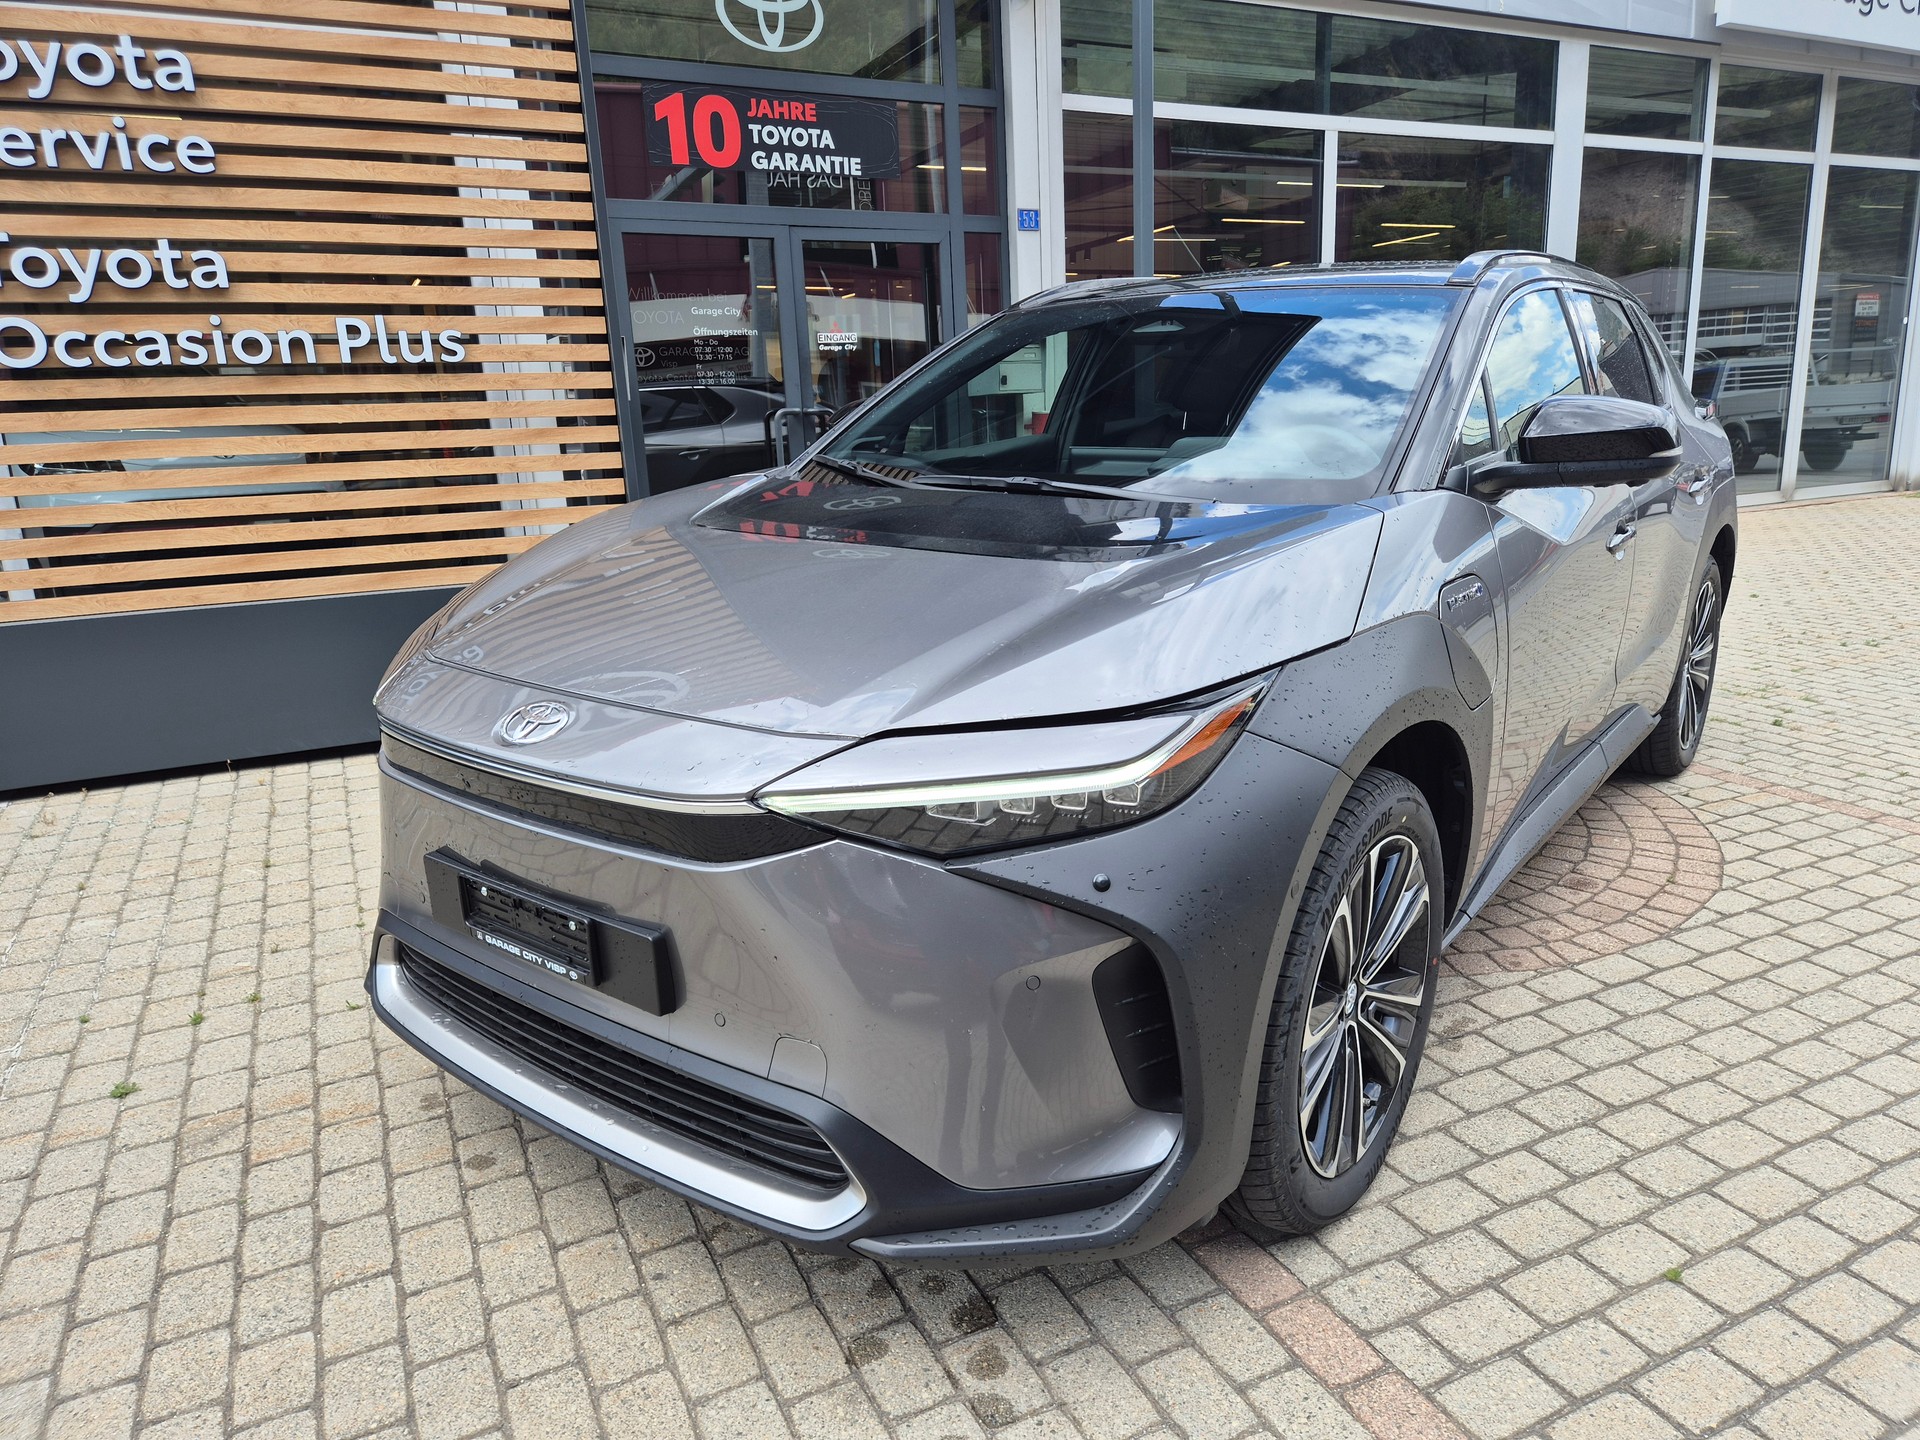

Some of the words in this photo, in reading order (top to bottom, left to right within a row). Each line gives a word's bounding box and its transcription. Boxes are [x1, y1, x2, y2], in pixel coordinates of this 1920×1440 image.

[747, 98, 817, 122] JAHRE
[654, 92, 742, 168] 10
[748, 124, 835, 149] TOYOTA
[751, 151, 862, 176] GARANTIE
[1023, 210, 1035, 228] 53
[0, 231, 229, 303] oyota
[708, 287, 727, 301] bei
[632, 311, 685, 325] OYOTA
[691, 306, 723, 317] Garage
[724, 306, 741, 317] City
[0, 315, 317, 369] Occasion
[335, 315, 466, 364] Plus
[693, 325, 758, 338] Öffnungszeiten
[819, 333, 857, 341] EINGANG
[661, 360, 678, 369] Visp
[485, 935, 521, 956] GARAGE
[522, 950, 543, 965] CITY
[545, 959, 567, 975] VISP
